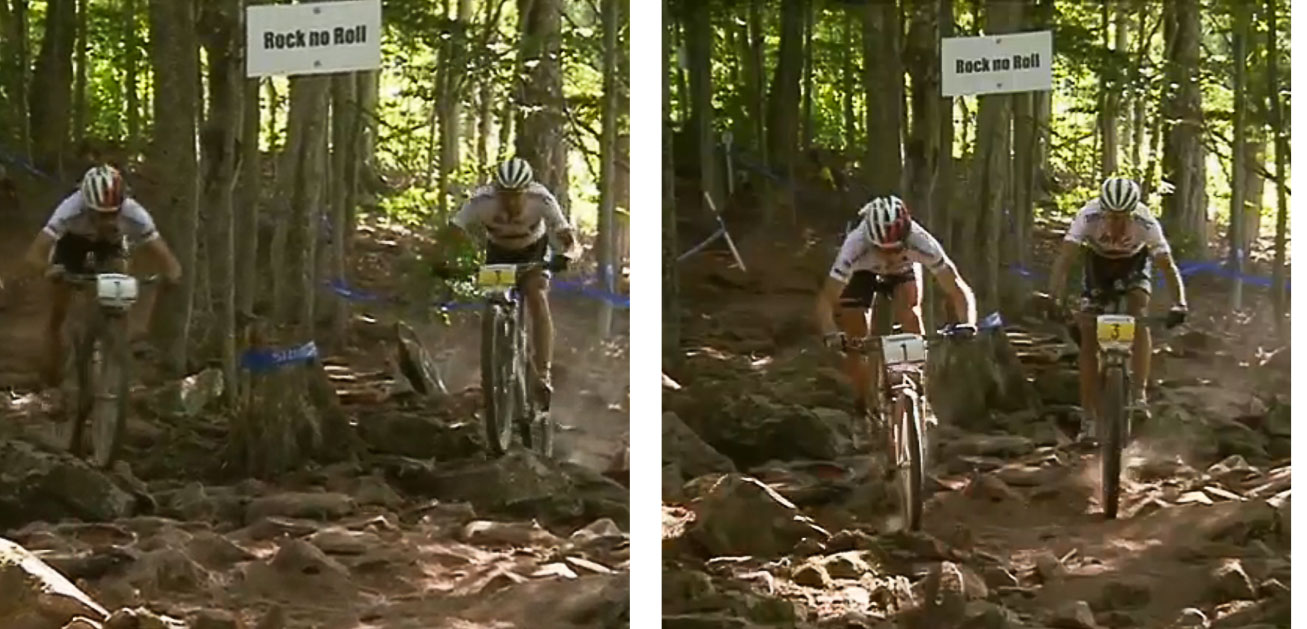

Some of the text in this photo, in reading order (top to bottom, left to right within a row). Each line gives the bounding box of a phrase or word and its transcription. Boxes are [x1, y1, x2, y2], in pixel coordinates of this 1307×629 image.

[263, 25, 367, 49] Rock no Roll
[955, 53, 1040, 74] Rock no Roll
[1110, 323, 1120, 340] 3
[900, 343, 908, 361] 1
